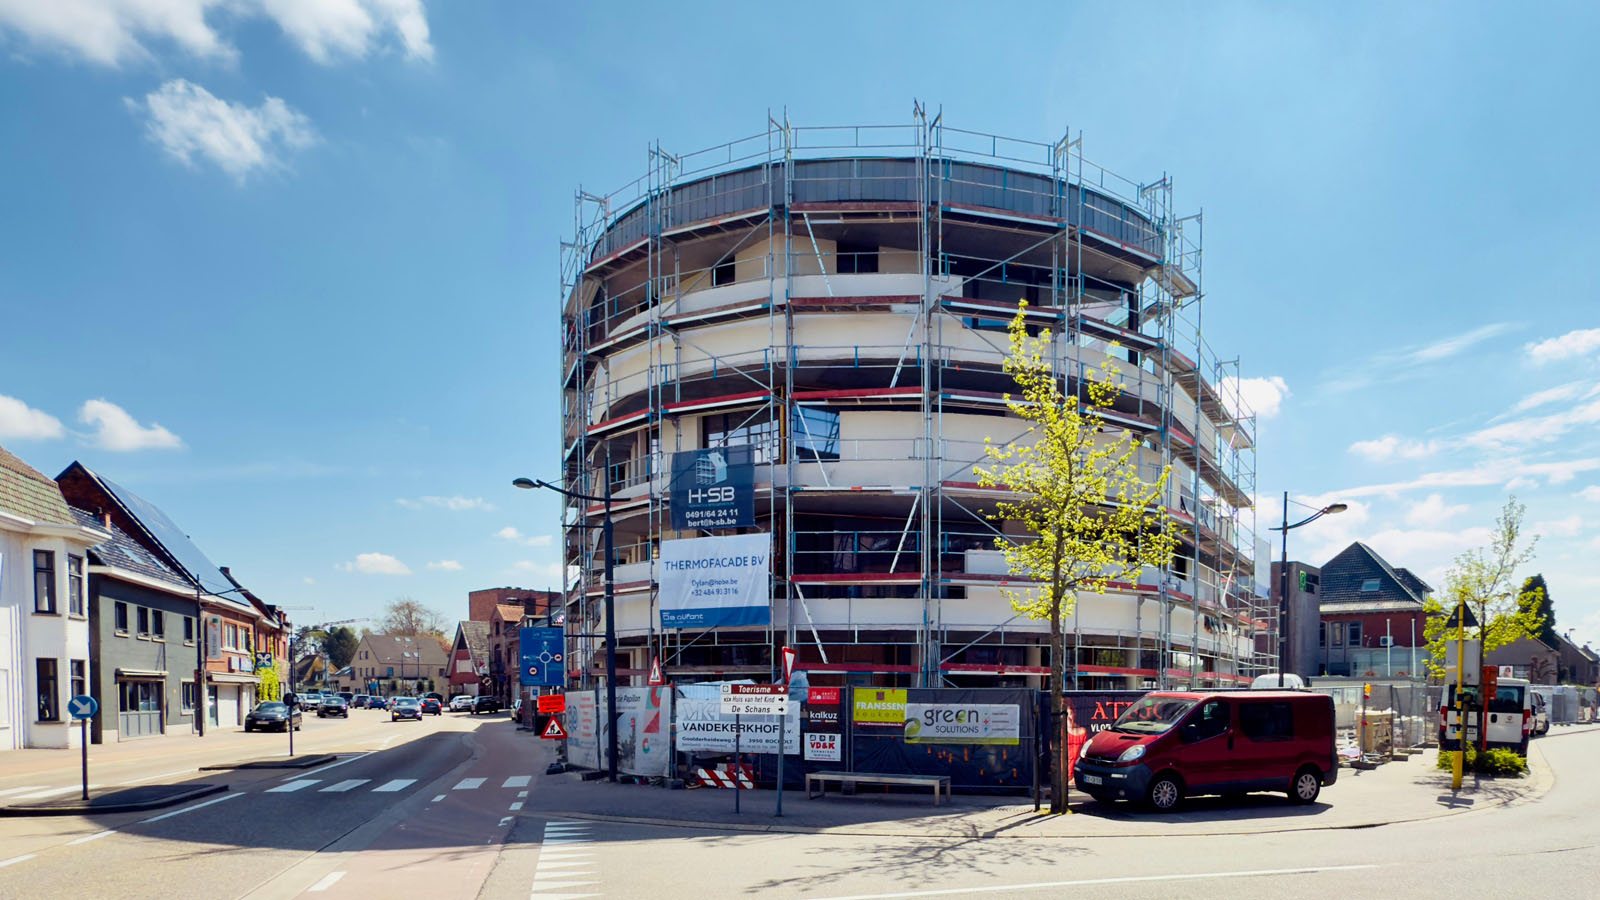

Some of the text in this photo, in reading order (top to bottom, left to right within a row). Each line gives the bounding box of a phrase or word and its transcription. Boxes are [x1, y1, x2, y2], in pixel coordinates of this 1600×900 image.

[688, 486, 735, 503] H-SB
[717, 509, 727, 517] 24
[730, 508, 739, 516] 11
[688, 518, 737, 527] bert@h-sb.be
[664, 555, 765, 571] THERMOFACADE BV
[739, 685, 771, 693] Toerisme
[731, 705, 771, 713] De Schans
[856, 701, 905, 710] FRANSSEN
[924, 708, 979, 726] green
[936, 725, 979, 734] SOLUTIONS
